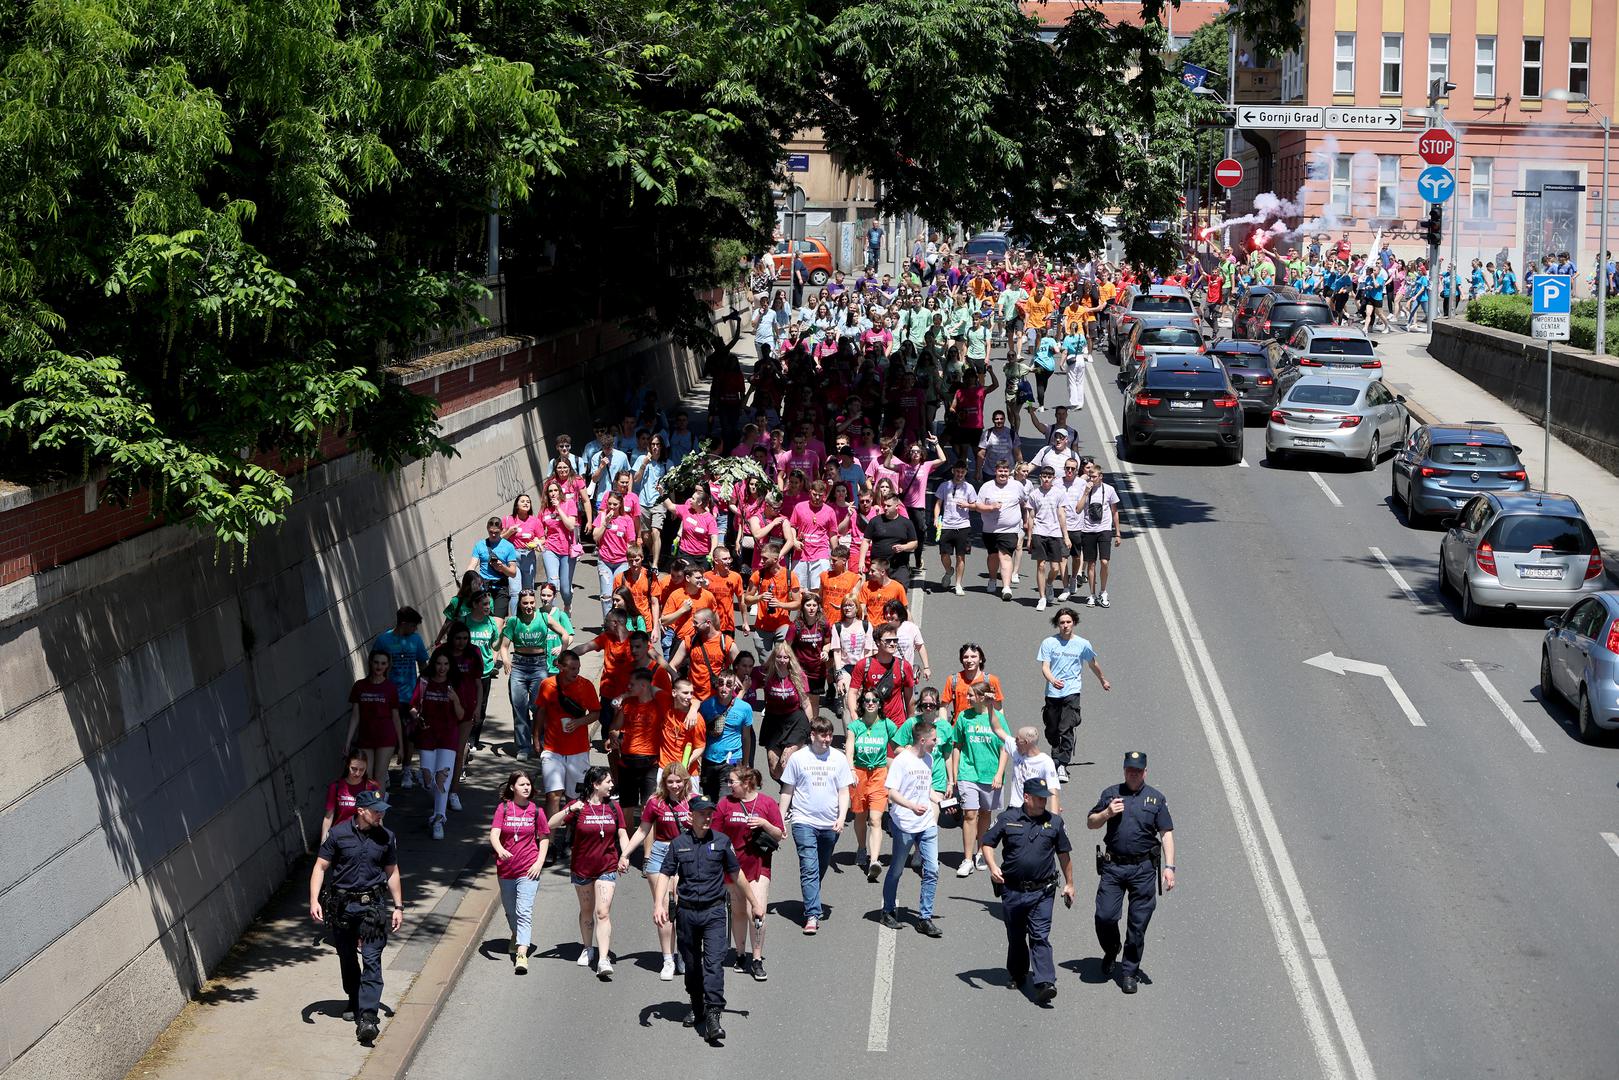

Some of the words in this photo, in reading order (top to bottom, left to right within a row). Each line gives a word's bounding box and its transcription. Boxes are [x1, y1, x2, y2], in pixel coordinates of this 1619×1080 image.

[1259, 111, 1291, 125] Gornji
[1294, 112, 1319, 123] Grad
[1342, 113, 1382, 124] Centar
[1421, 139, 1453, 155] STOP
[1543, 285, 1560, 308] P
